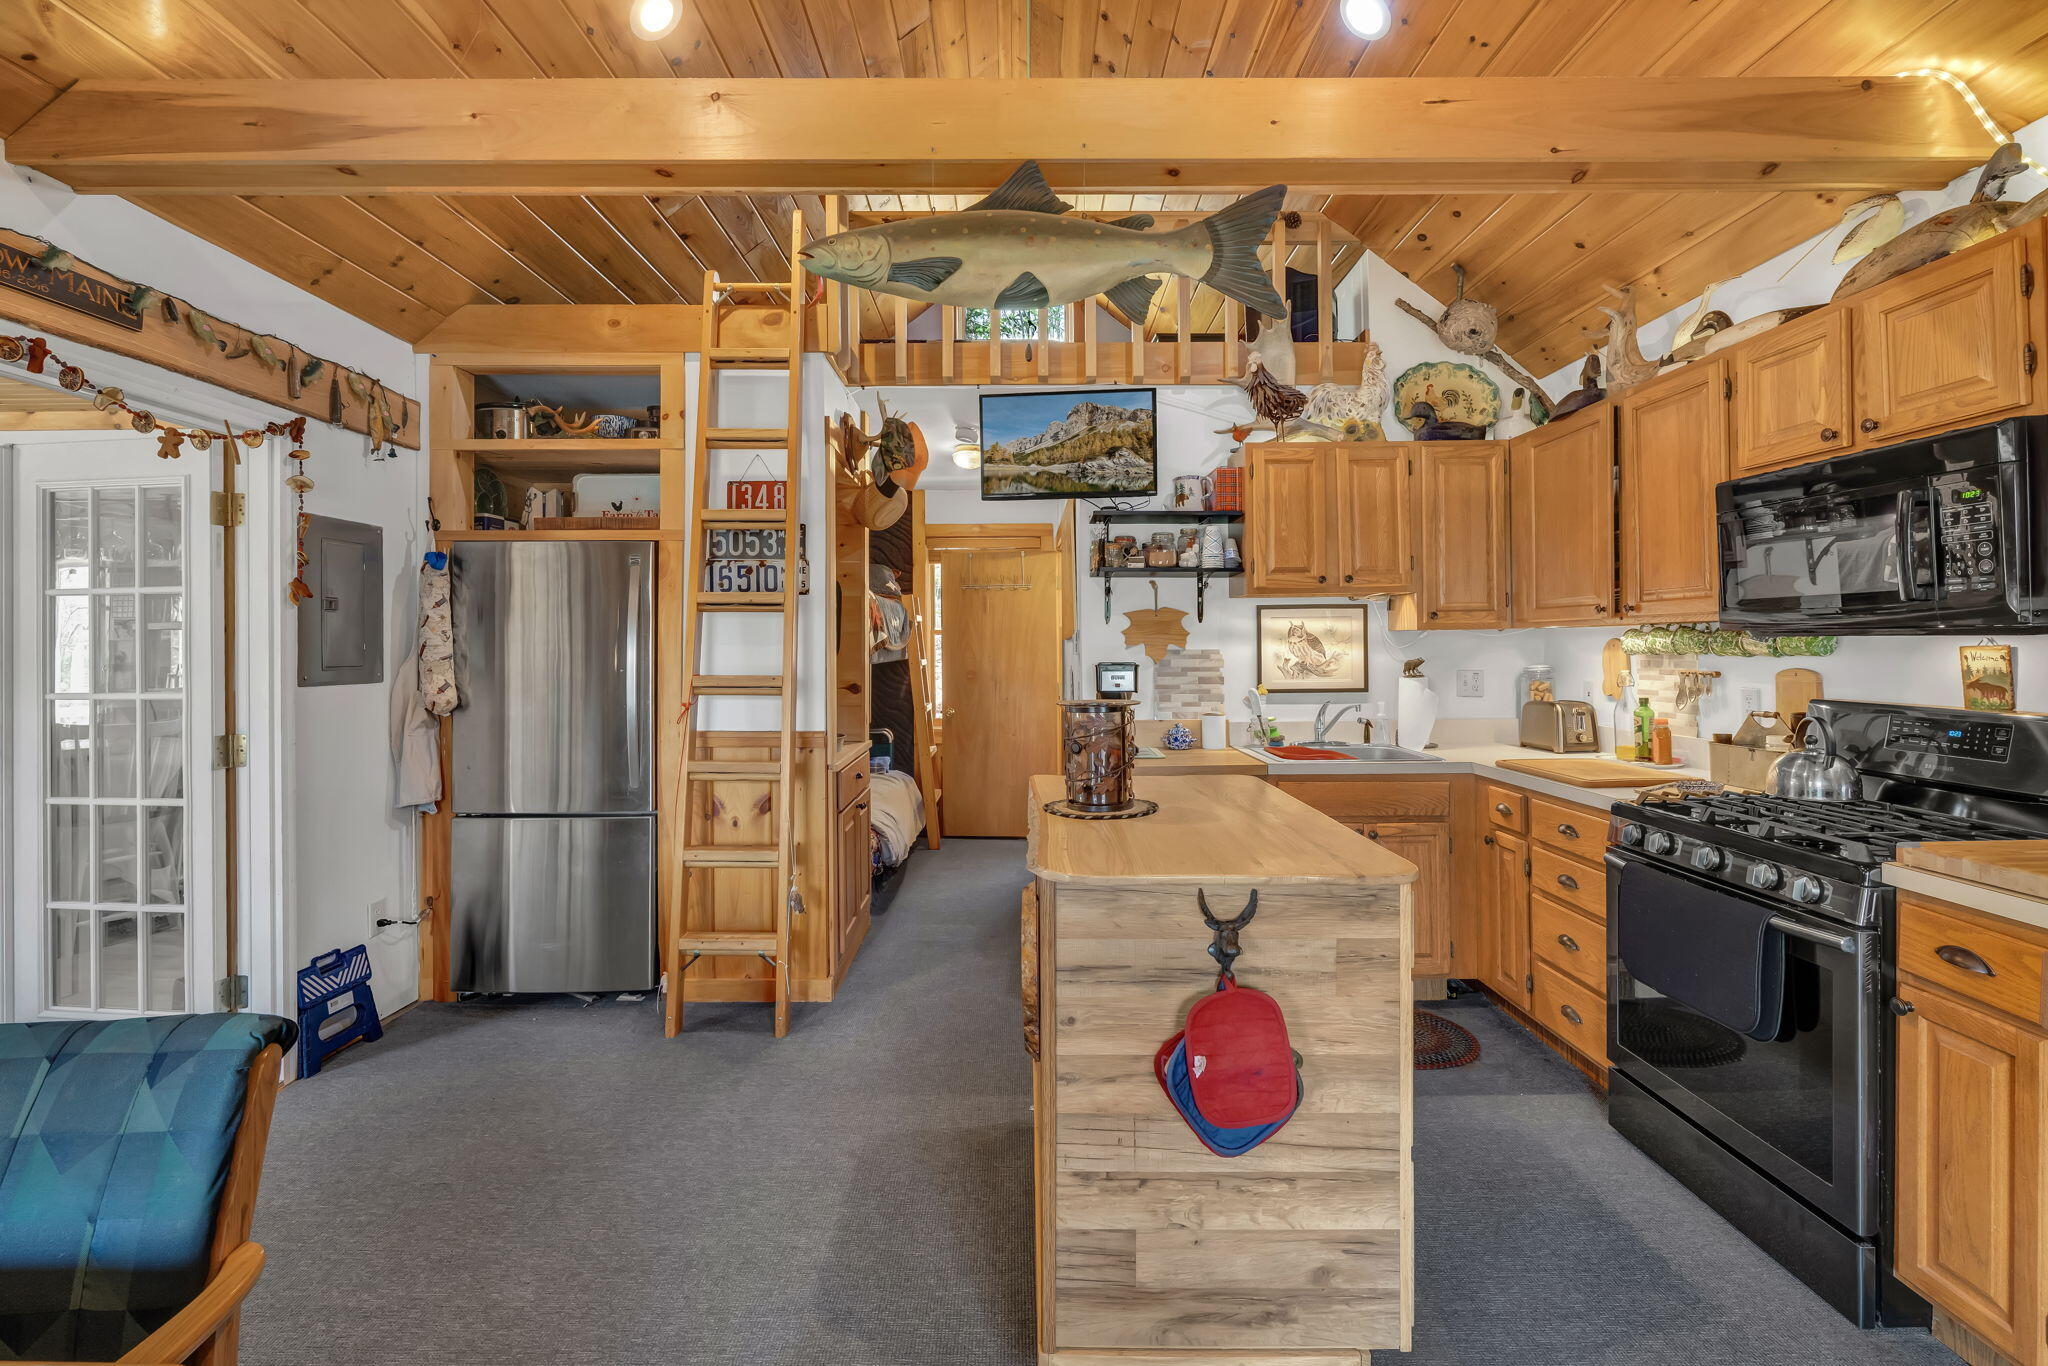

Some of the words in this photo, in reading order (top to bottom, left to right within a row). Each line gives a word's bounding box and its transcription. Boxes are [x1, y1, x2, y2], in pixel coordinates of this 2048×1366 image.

[50, 266, 139, 320] MAINE
[731, 483, 785, 509] 1348
[712, 529, 777, 557] 5053
